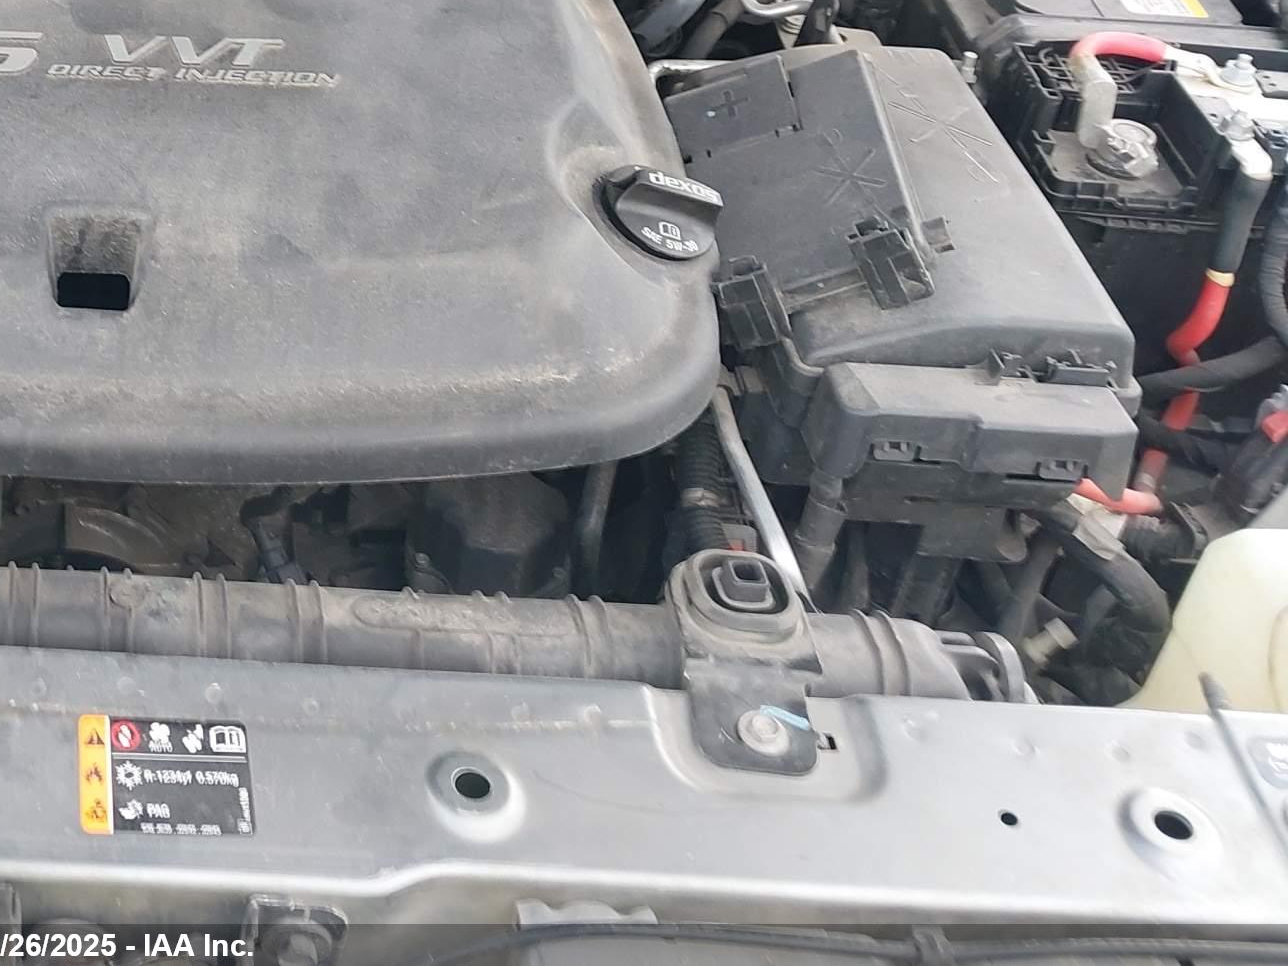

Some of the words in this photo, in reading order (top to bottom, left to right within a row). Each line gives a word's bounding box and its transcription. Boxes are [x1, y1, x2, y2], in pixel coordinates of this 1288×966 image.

[105, 33, 286, 67] VVT
[46, 63, 168, 81] DIRECT
[175, 65, 341, 87] INJECTION
[641, 226, 663, 245] SAE
